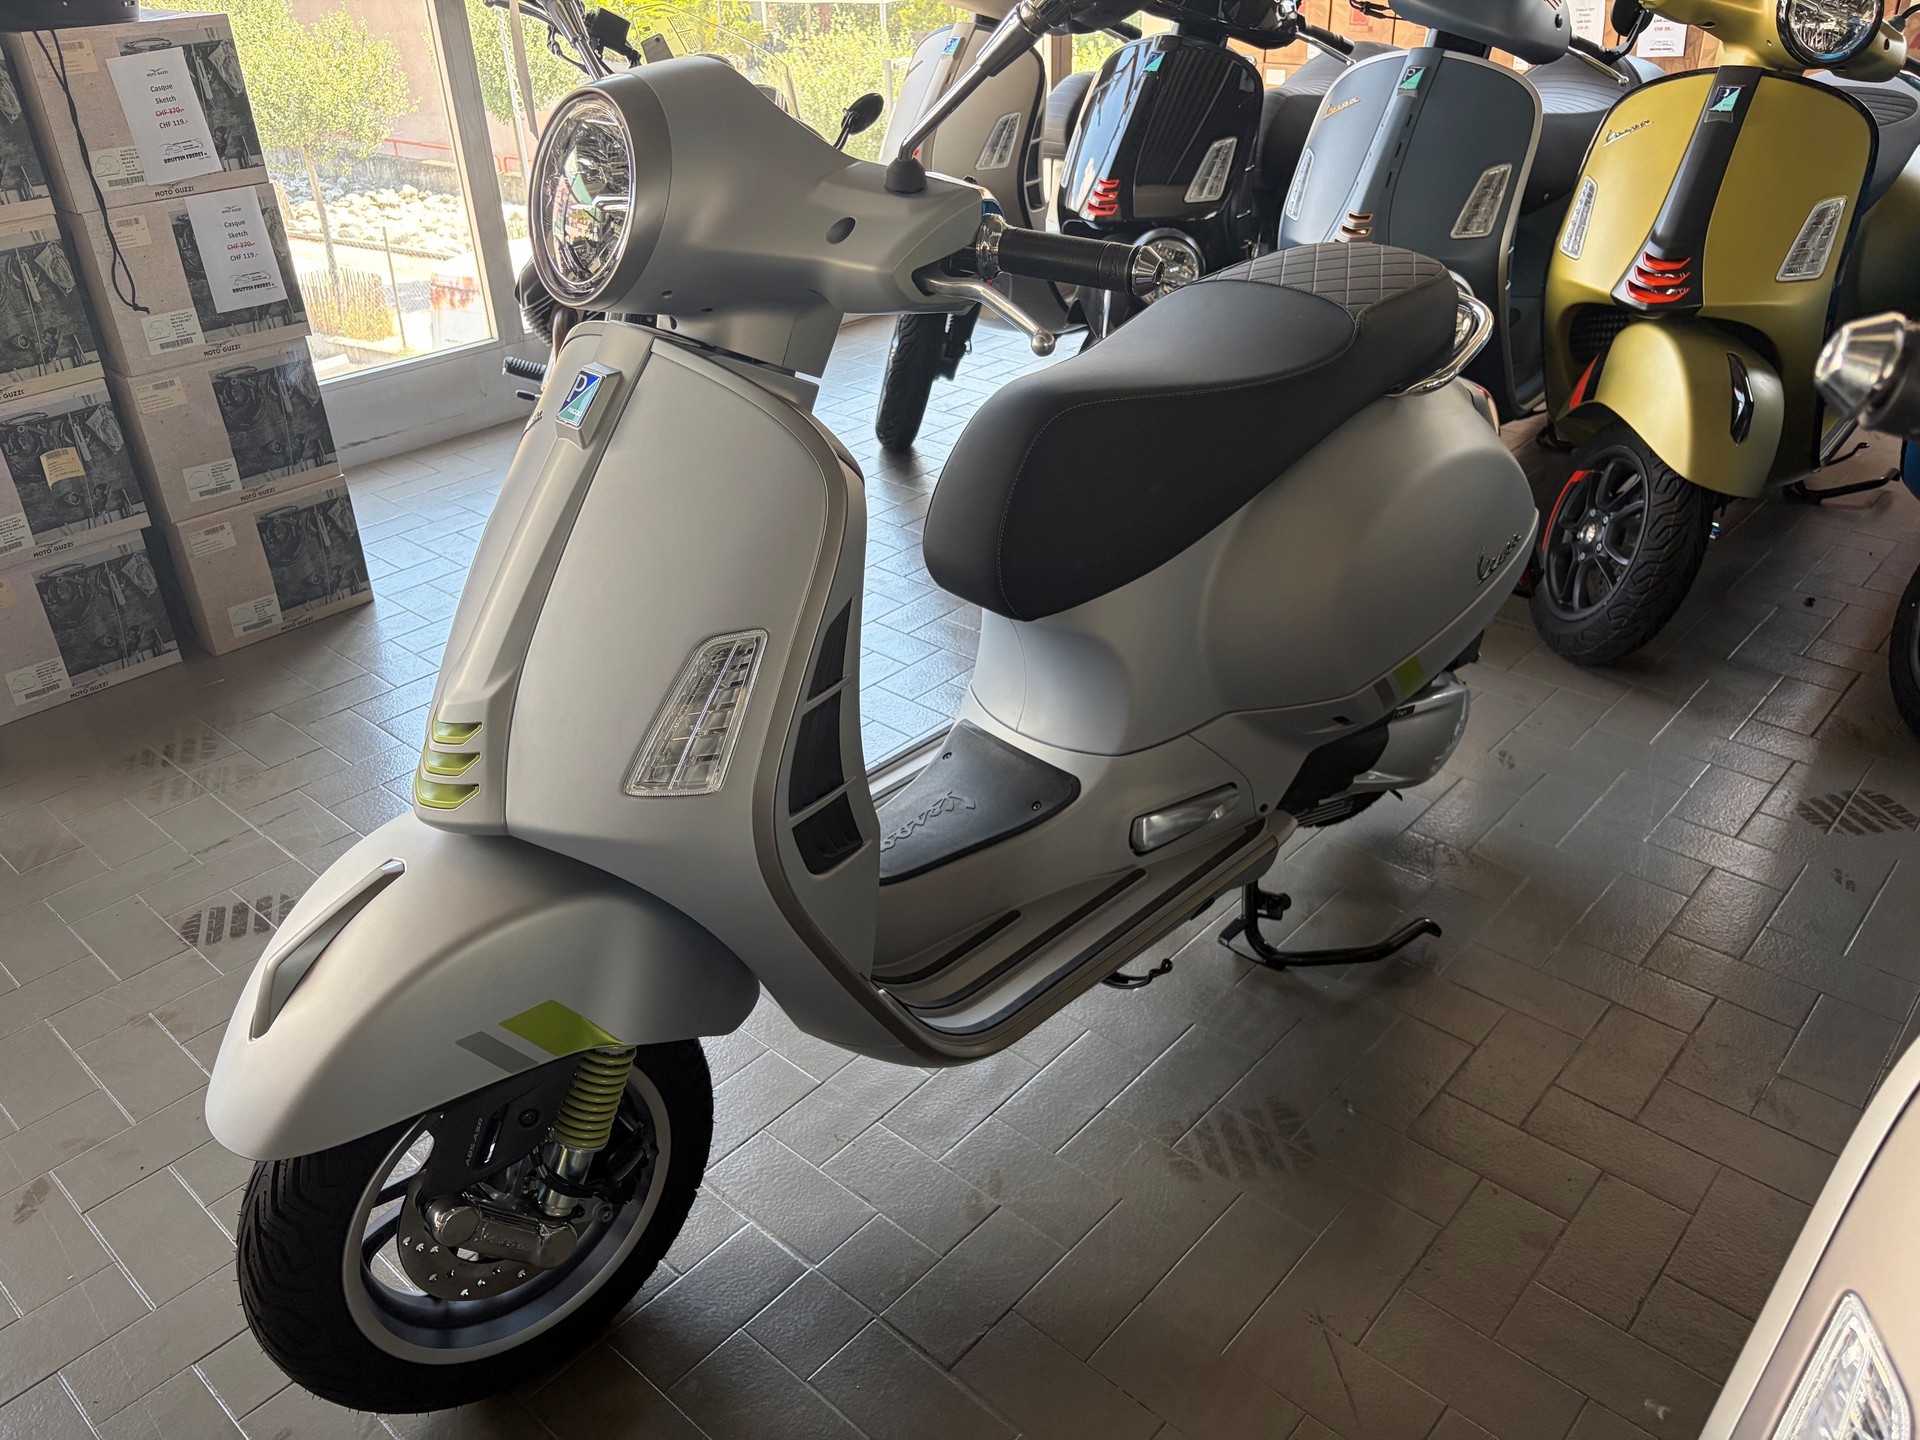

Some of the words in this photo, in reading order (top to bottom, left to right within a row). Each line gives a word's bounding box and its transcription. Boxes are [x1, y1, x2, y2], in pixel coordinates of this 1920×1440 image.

[150, 83, 173, 93] Casque
[155, 95, 177, 105] Sketch
[155, 109, 168, 117] CHF
[159, 120, 171, 129] CHF
[173, 118, 189, 127] 119.-
[155, 188, 173, 198] MOTO
[174, 186, 195, 195] GUZZI
[223, 219, 246, 229] Casque
[227, 230, 248, 239] Sketch
[227, 243, 240, 251] CHF
[230, 253, 241, 261] CHF
[243, 251, 258, 259] 119.-
[203, 348, 221, 357] MOTO
[222, 343, 242, 353] GUZZI
[2, 388, 25, 399] GUZZI
[240, 492, 257, 501] MOTO
[258, 486, 276, 496] GUZZI
[33, 547, 52, 558] MOTO
[53, 541, 75, 552] GUZZI
[281, 622, 297, 632] MOTO
[297, 616, 314, 626] GUZZI
[70, 689, 89, 699] MOTO
[89, 681, 110, 692] GUZZI
